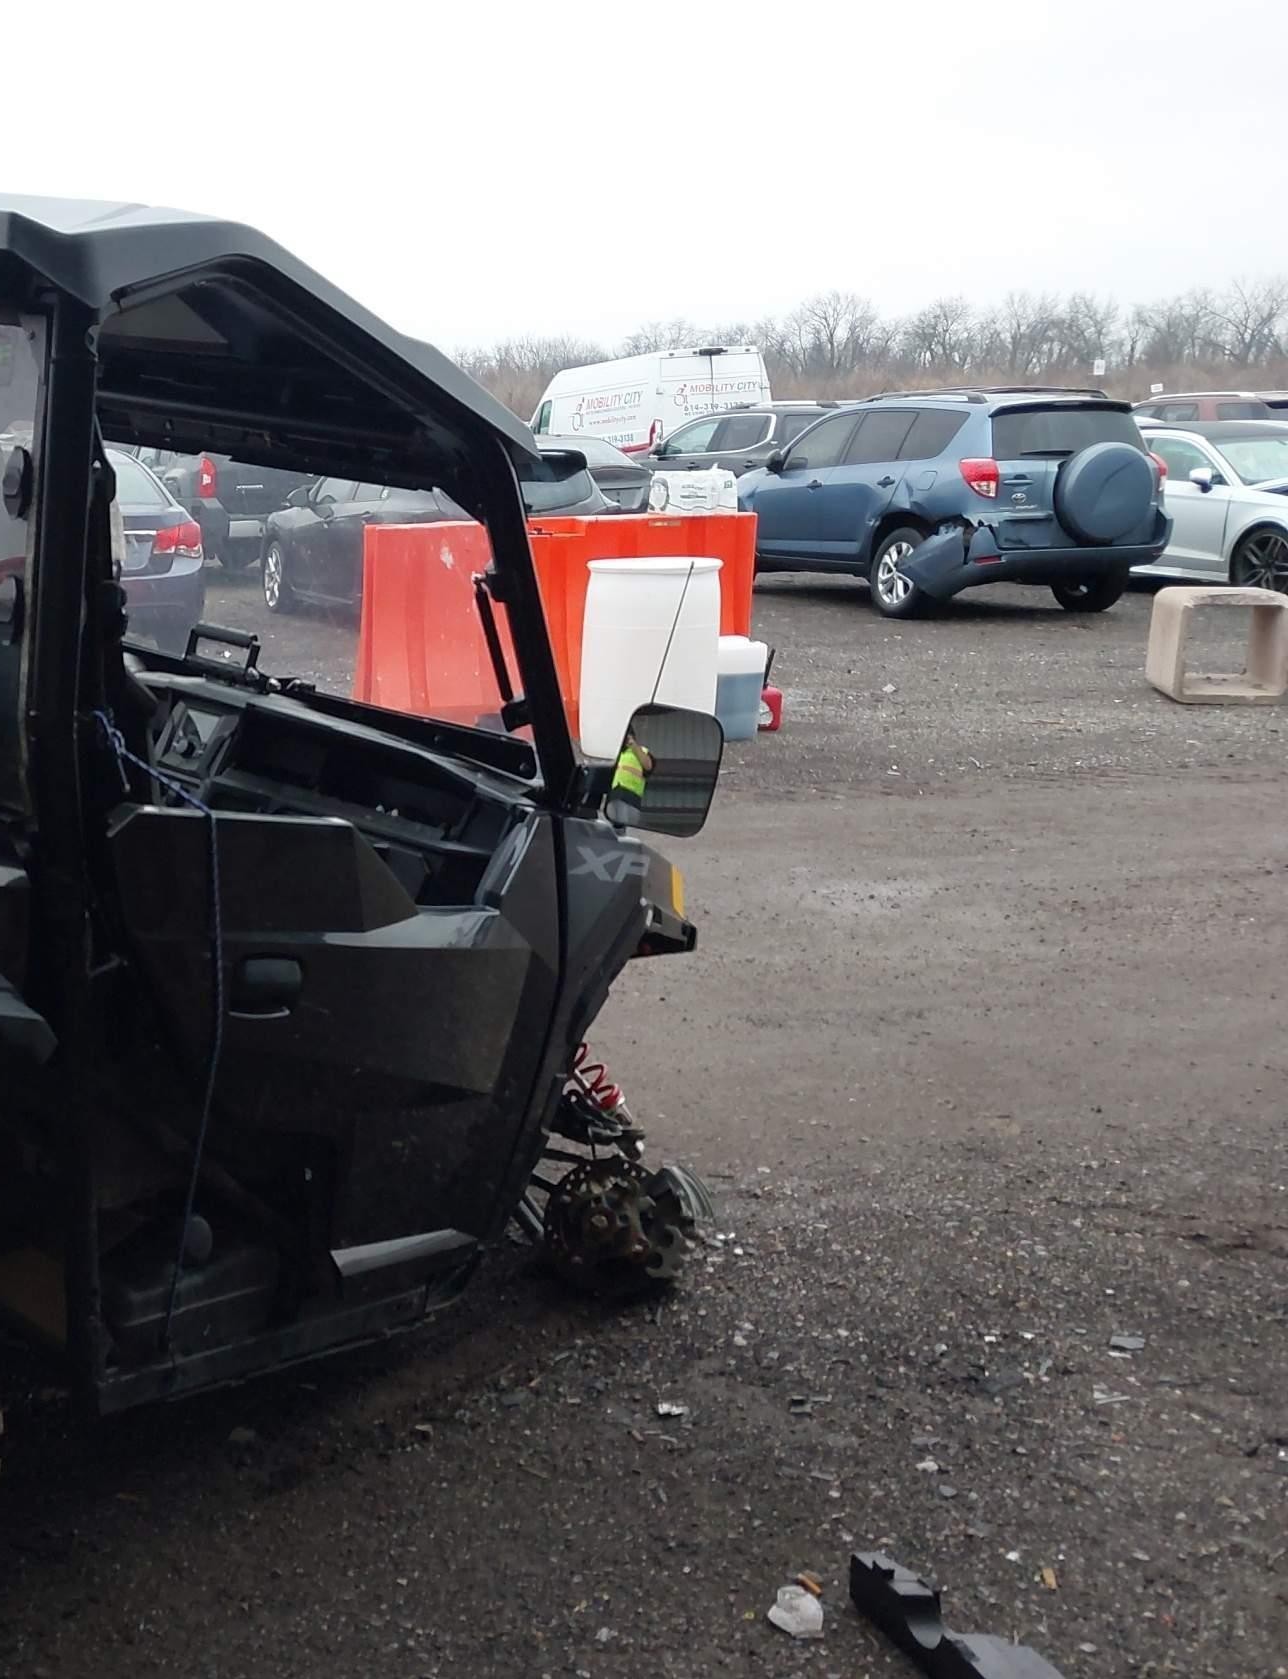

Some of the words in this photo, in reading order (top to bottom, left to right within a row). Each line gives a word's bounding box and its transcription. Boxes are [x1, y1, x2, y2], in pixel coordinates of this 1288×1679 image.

[689, 383, 736, 393] MOBILITY
[737, 381, 759, 391] CITY
[586, 393, 623, 410] MOBILITY
[624, 391, 642, 405] CITY
[569, 846, 651, 883] XP
